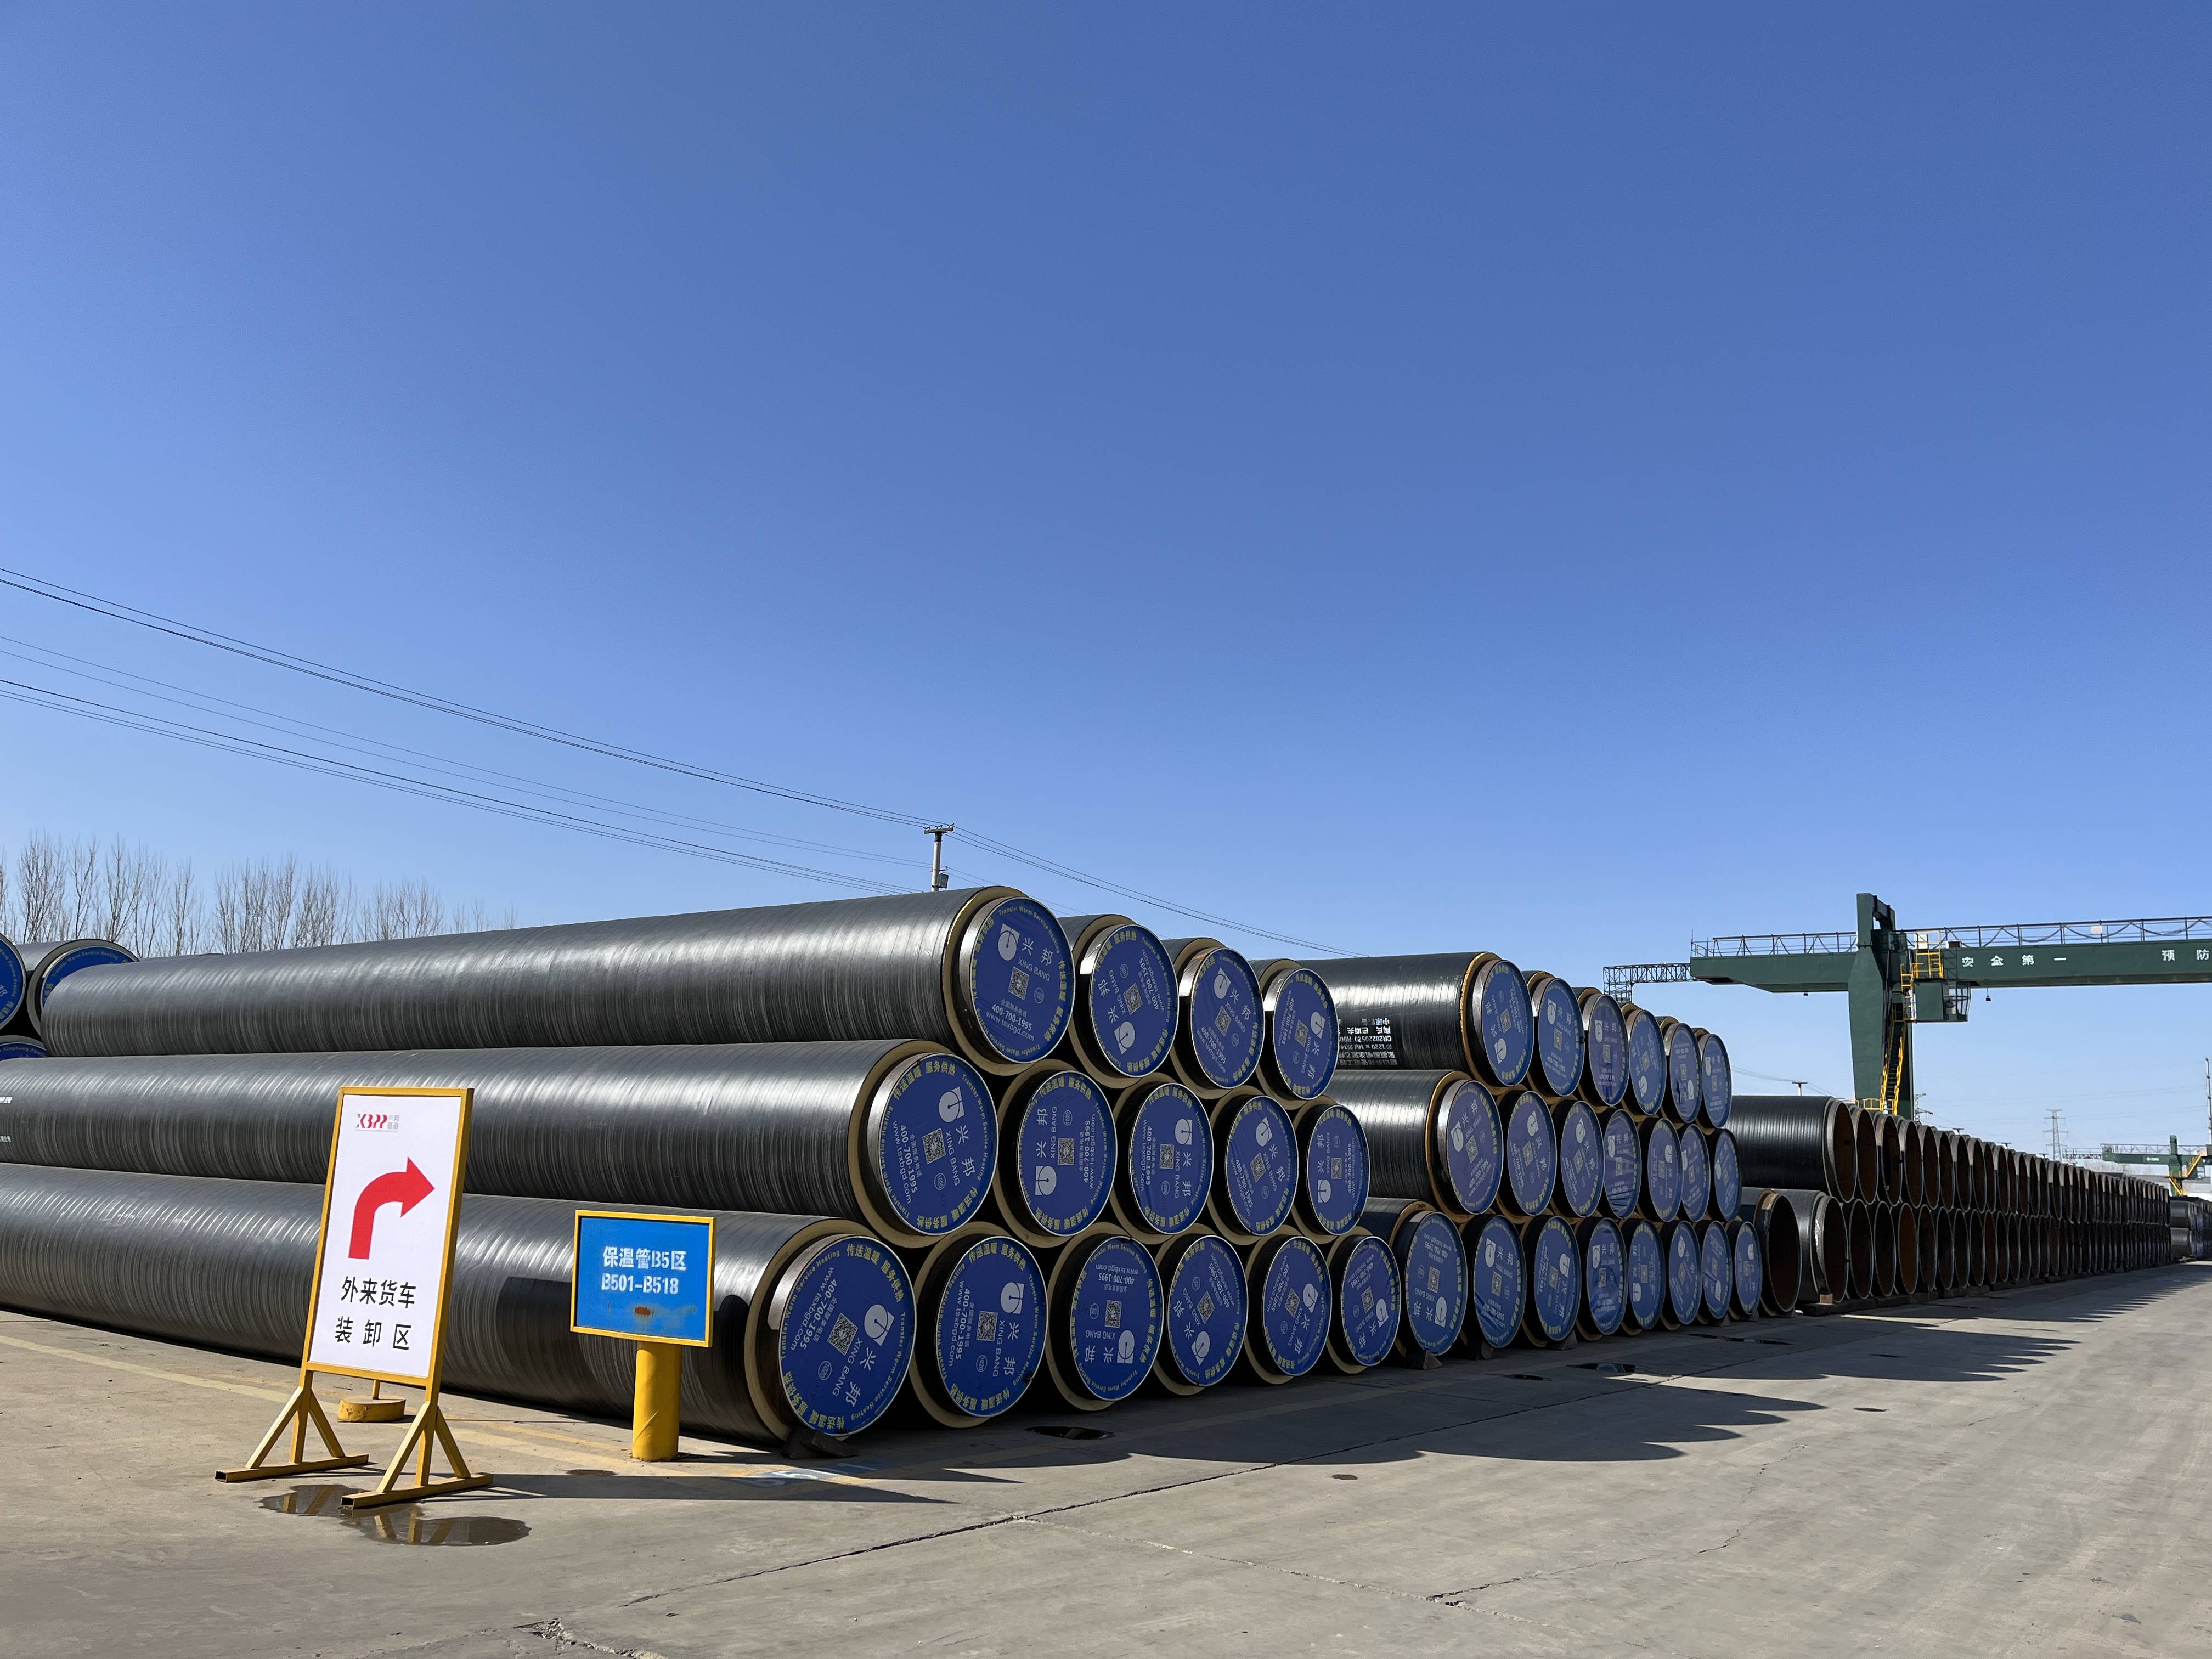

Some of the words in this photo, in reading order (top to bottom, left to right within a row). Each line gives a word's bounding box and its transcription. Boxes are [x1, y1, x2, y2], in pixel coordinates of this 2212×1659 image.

[1022, 937, 1053, 966] 兴邦
[1962, 955, 2067, 967] 安全第一
[2162, 949, 2210, 961] 预防
[1018, 957, 1032, 972] XING
[1034, 966, 1050, 981] BANG
[991, 1003, 1032, 1031] 400-700-1995
[1035, 1108, 1047, 1158] 兴邦
[900, 1125, 917, 1193] 400-700-1995
[945, 1130, 954, 1155] XING
[950, 1157, 960, 1186] BANG
[955, 1125, 975, 1176] 兴邦
[602, 1246, 686, 1271] 保温管B5区
[340, 1276, 416, 1308] 外来货车
[601, 1273, 679, 1295] B501-B518
[800, 1278, 837, 1349] 400-700-1995
[955, 1288, 970, 1359] 400-700-1995
[335, 1316, 411, 1350] 装卸区
[996, 1319, 1005, 1344] XING
[847, 1337, 862, 1364] XING
[992, 1348, 1001, 1377] BANG
[1003, 1322, 1019, 1375] 兴邦
[832, 1365, 850, 1396] BANG
[845, 1347, 876, 1407] 兴邦
